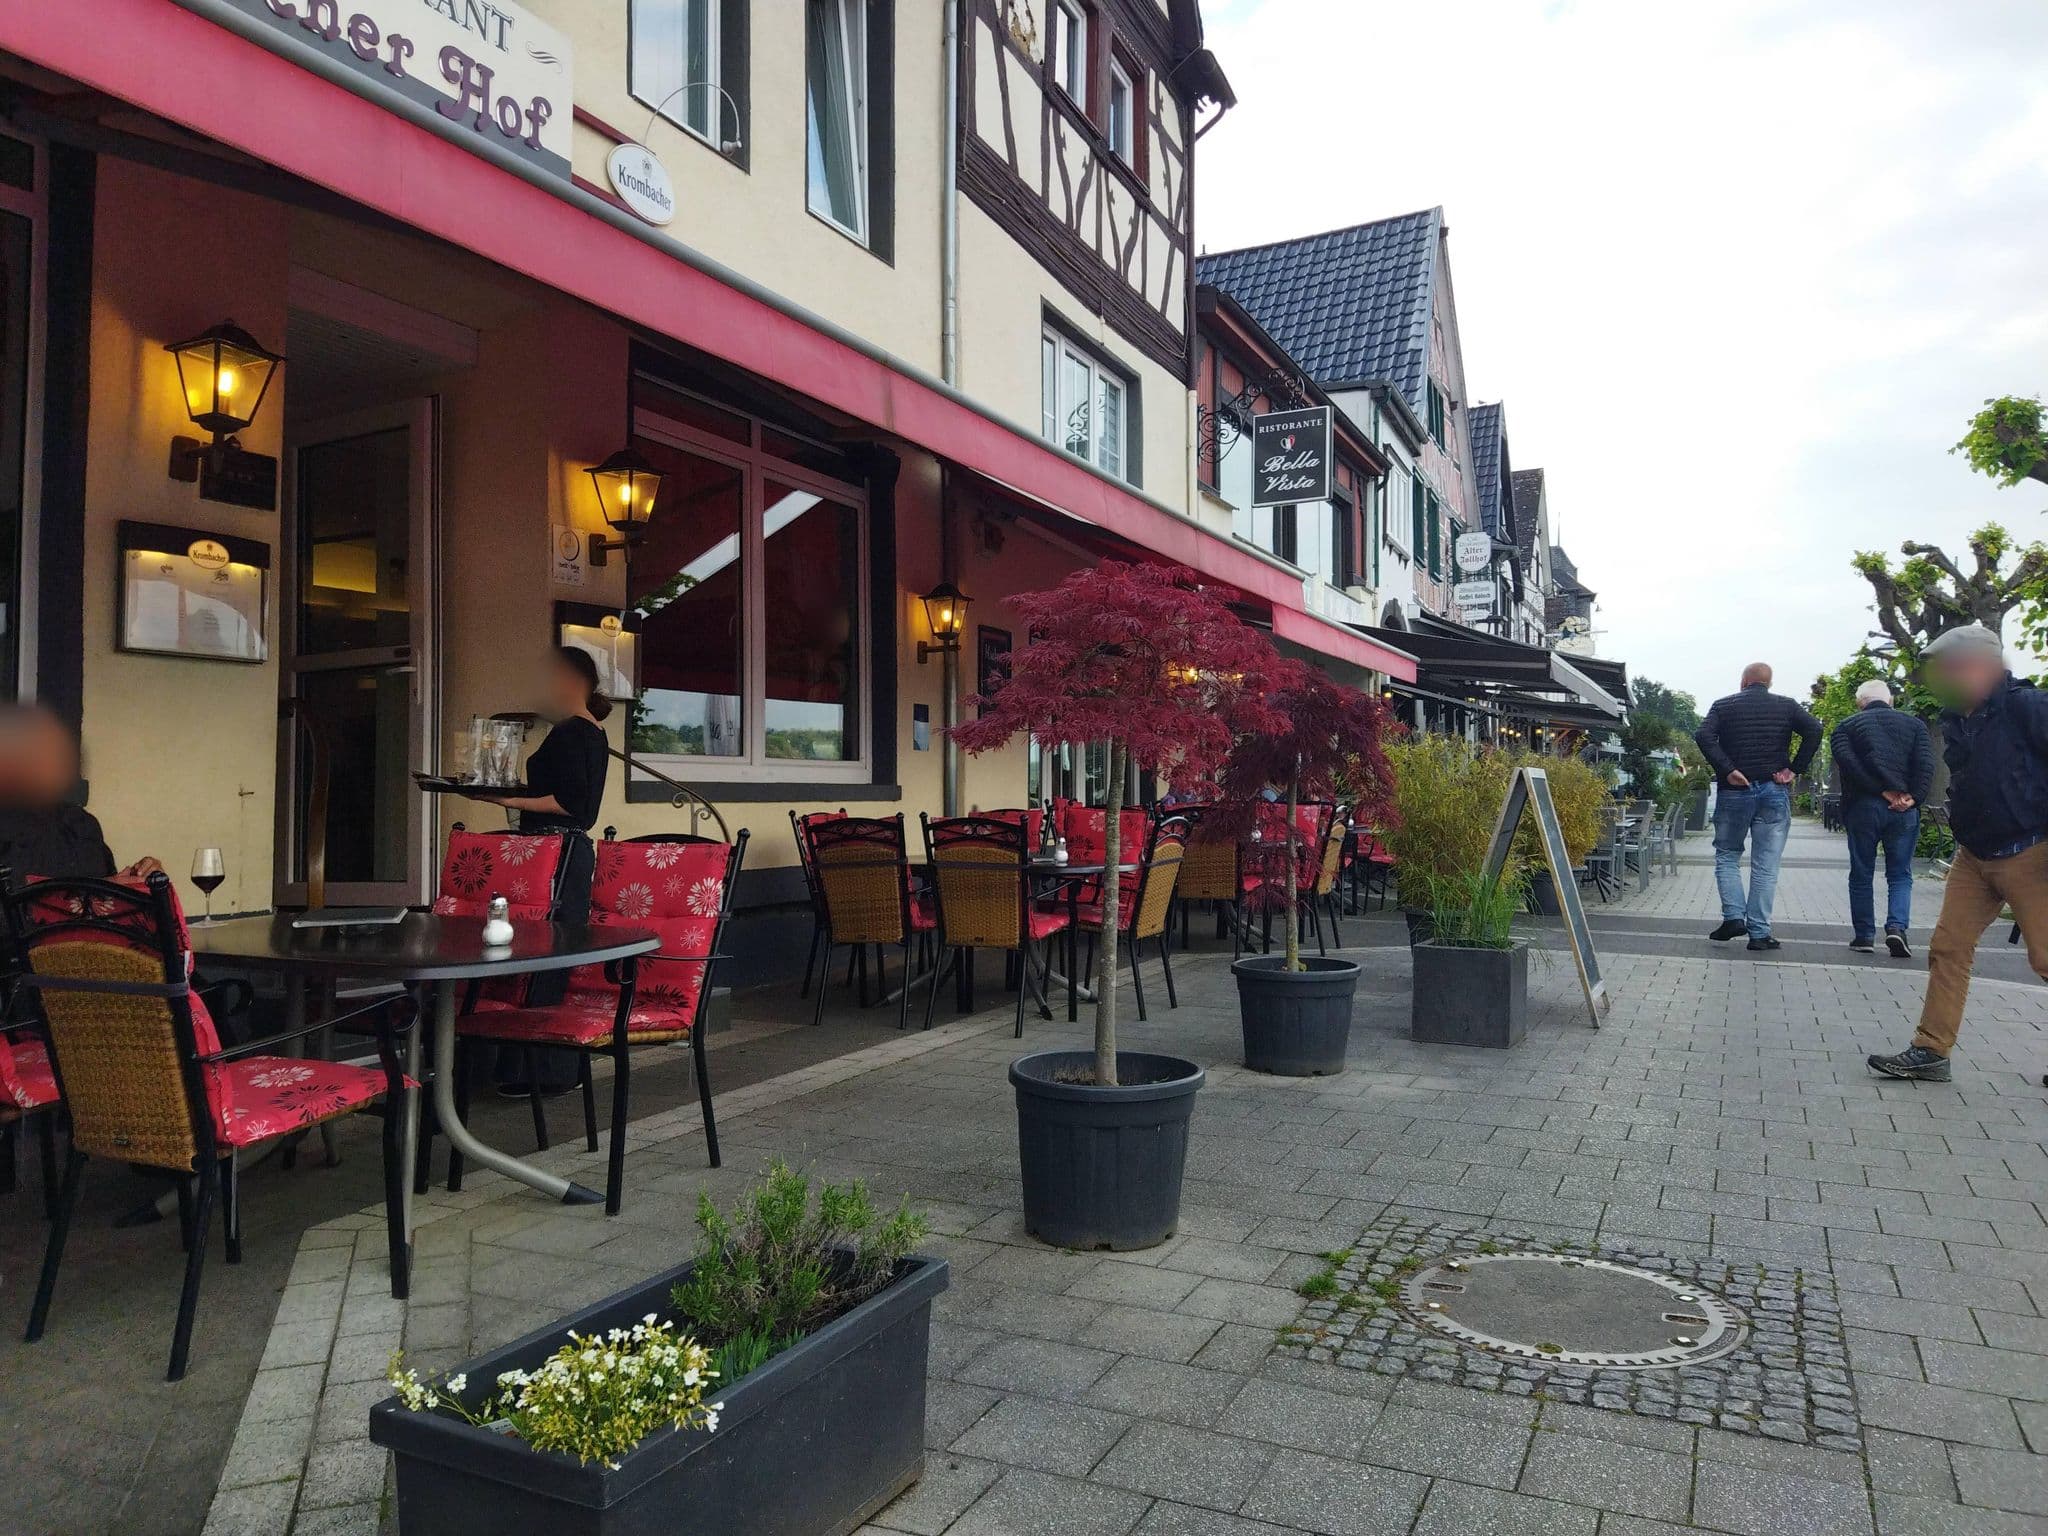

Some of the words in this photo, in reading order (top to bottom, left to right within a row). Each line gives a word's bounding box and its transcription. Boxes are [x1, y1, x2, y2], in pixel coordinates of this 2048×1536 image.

[435, 45, 552, 151] Hof
[618, 164, 671, 212] Krombacher
[1259, 418, 1323, 434] RISTORANTE
[1260, 450, 1320, 473] Bella
[1264, 474, 1316, 493] Vista
